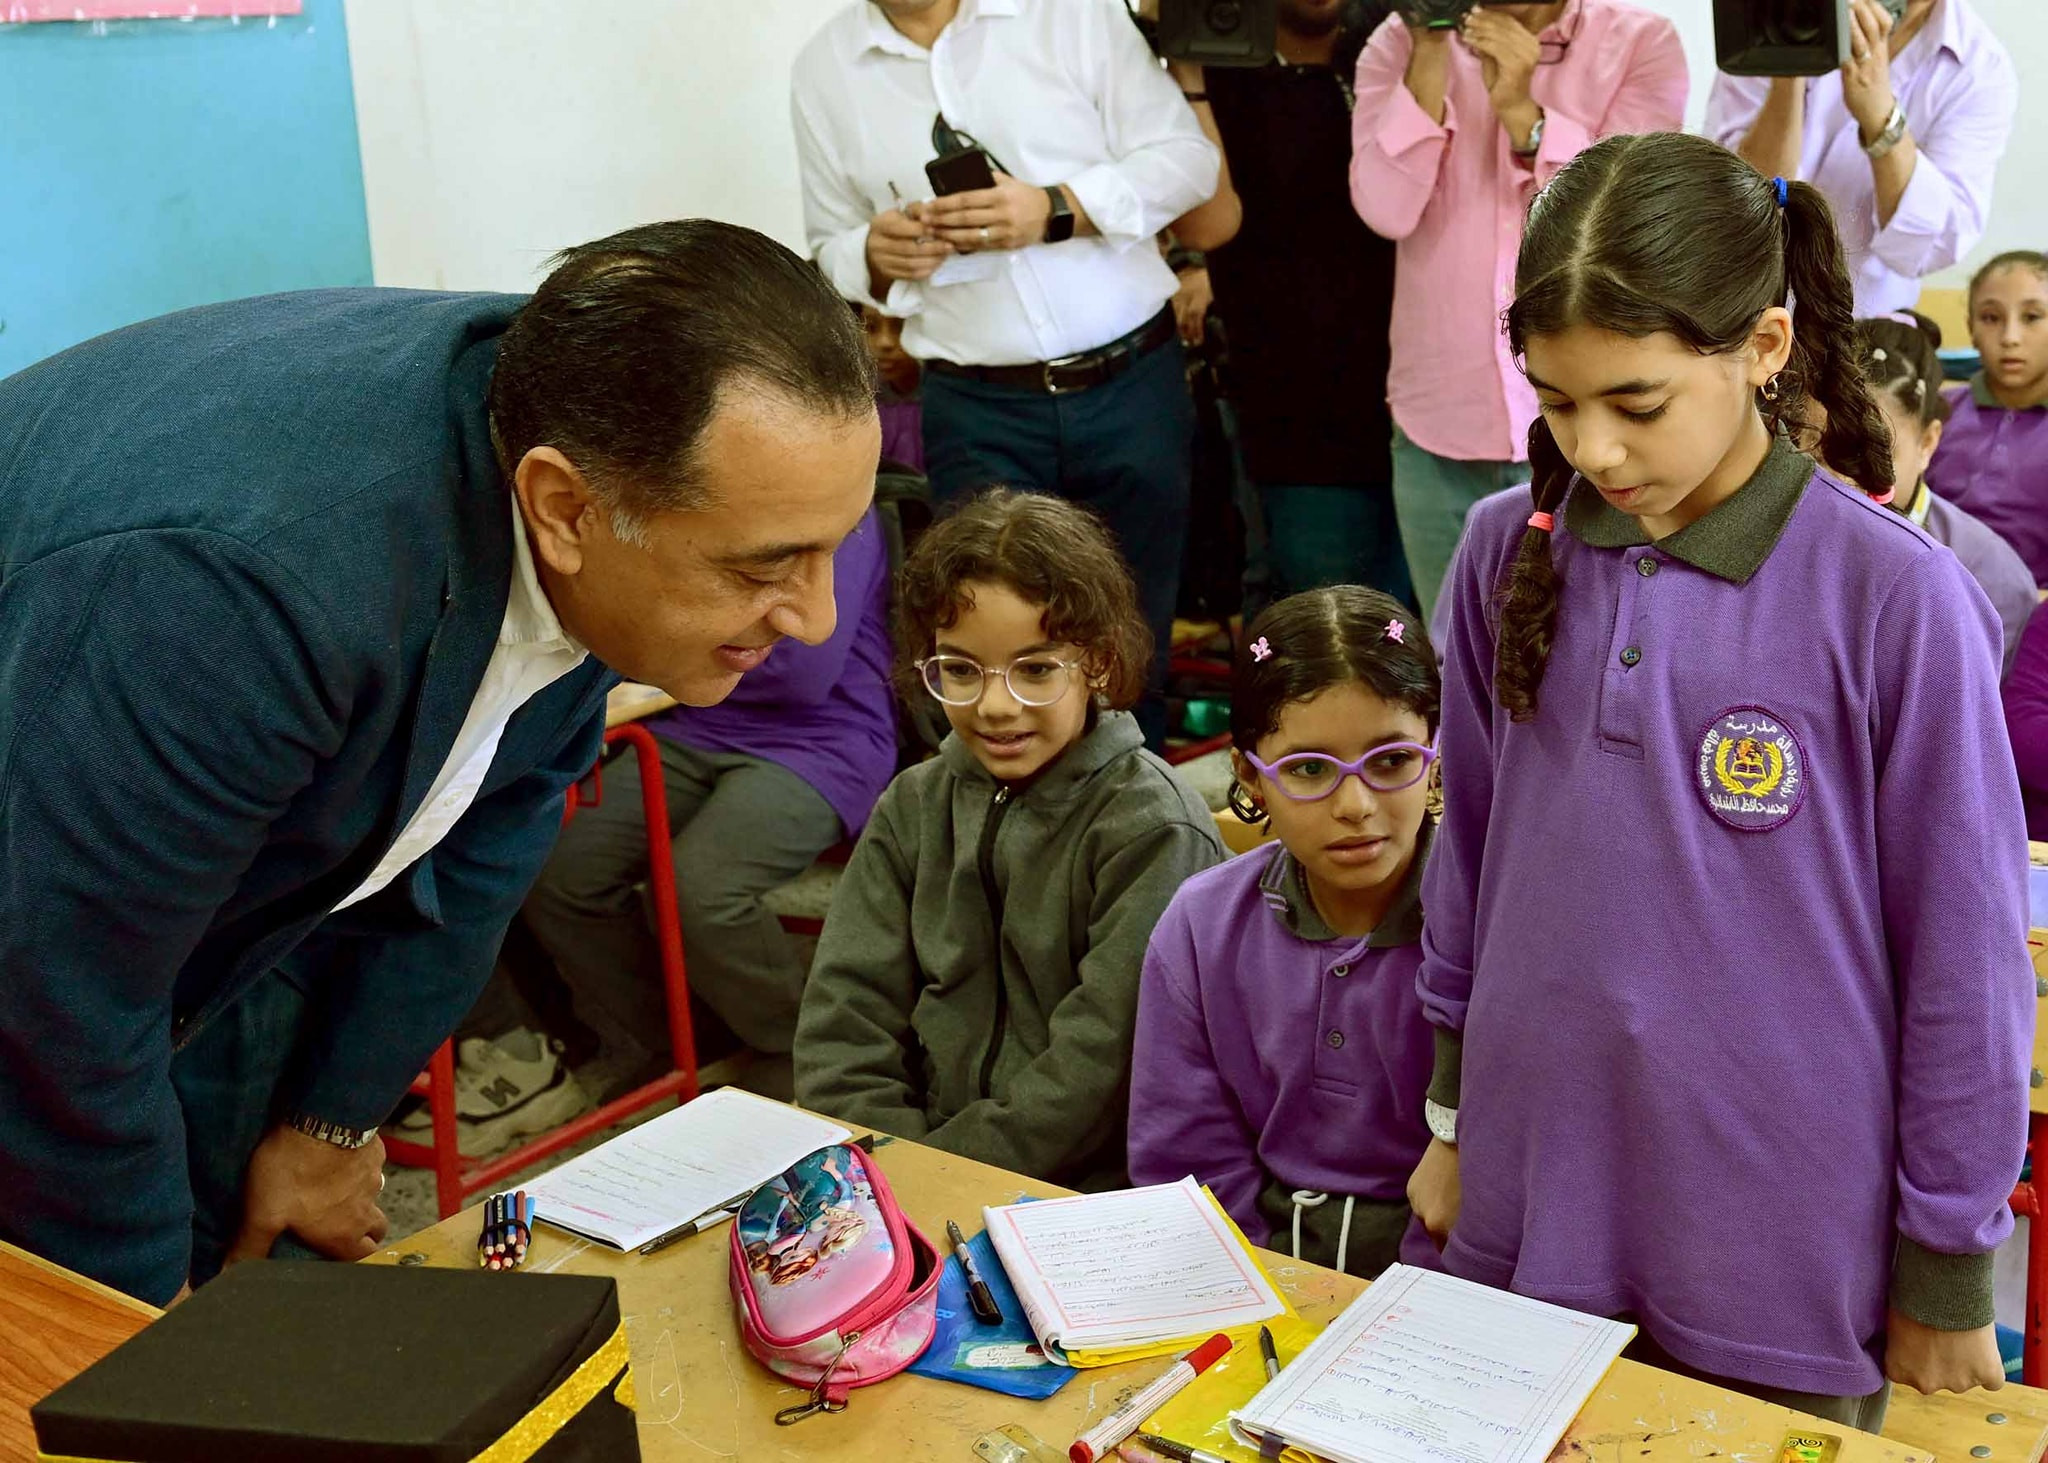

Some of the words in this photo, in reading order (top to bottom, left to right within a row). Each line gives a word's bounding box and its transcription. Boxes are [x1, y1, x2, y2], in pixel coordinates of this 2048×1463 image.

[1725, 714, 1778, 734] مدرسة
[1741, 796, 1766, 813] حافظ
[1765, 801, 1789, 815] محمد
